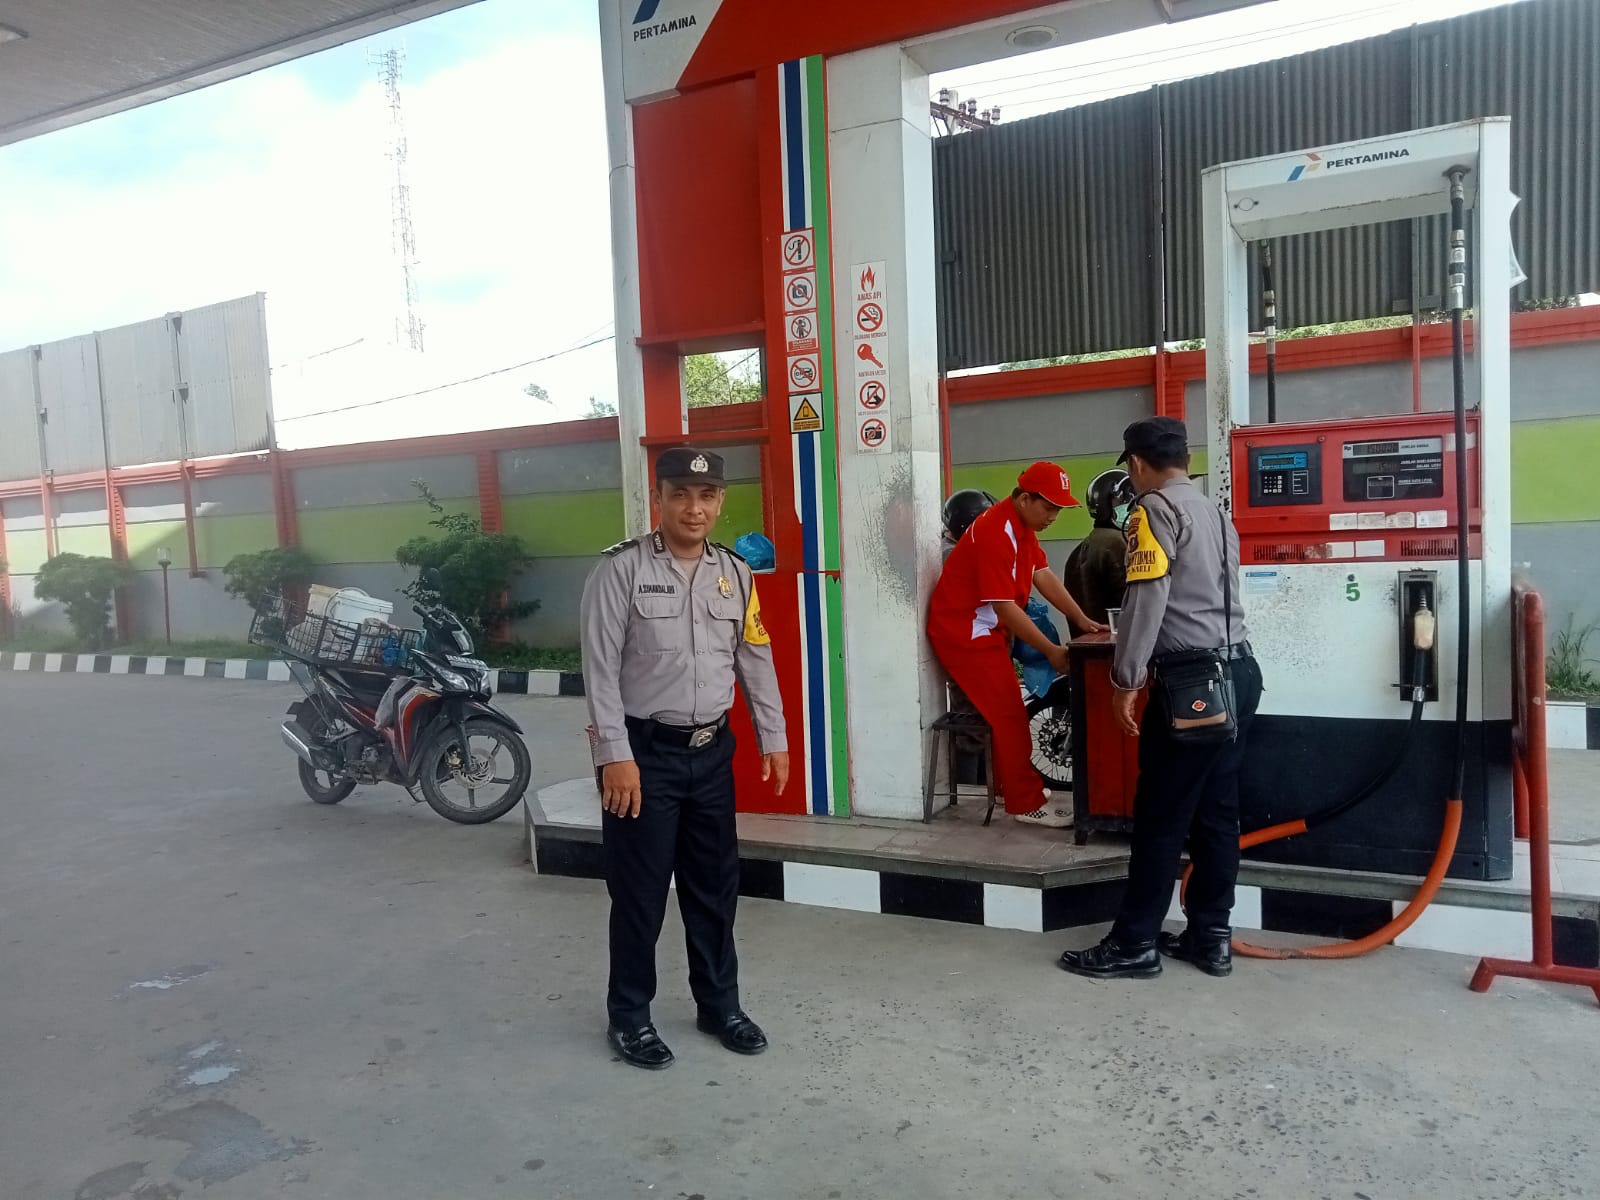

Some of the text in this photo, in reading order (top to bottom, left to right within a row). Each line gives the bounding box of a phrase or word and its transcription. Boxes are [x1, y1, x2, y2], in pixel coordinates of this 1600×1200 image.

[633, 15, 697, 42] PERTAMINA
[1326, 148, 1410, 169] PERTAMINA
[1345, 582, 1361, 602] 5
